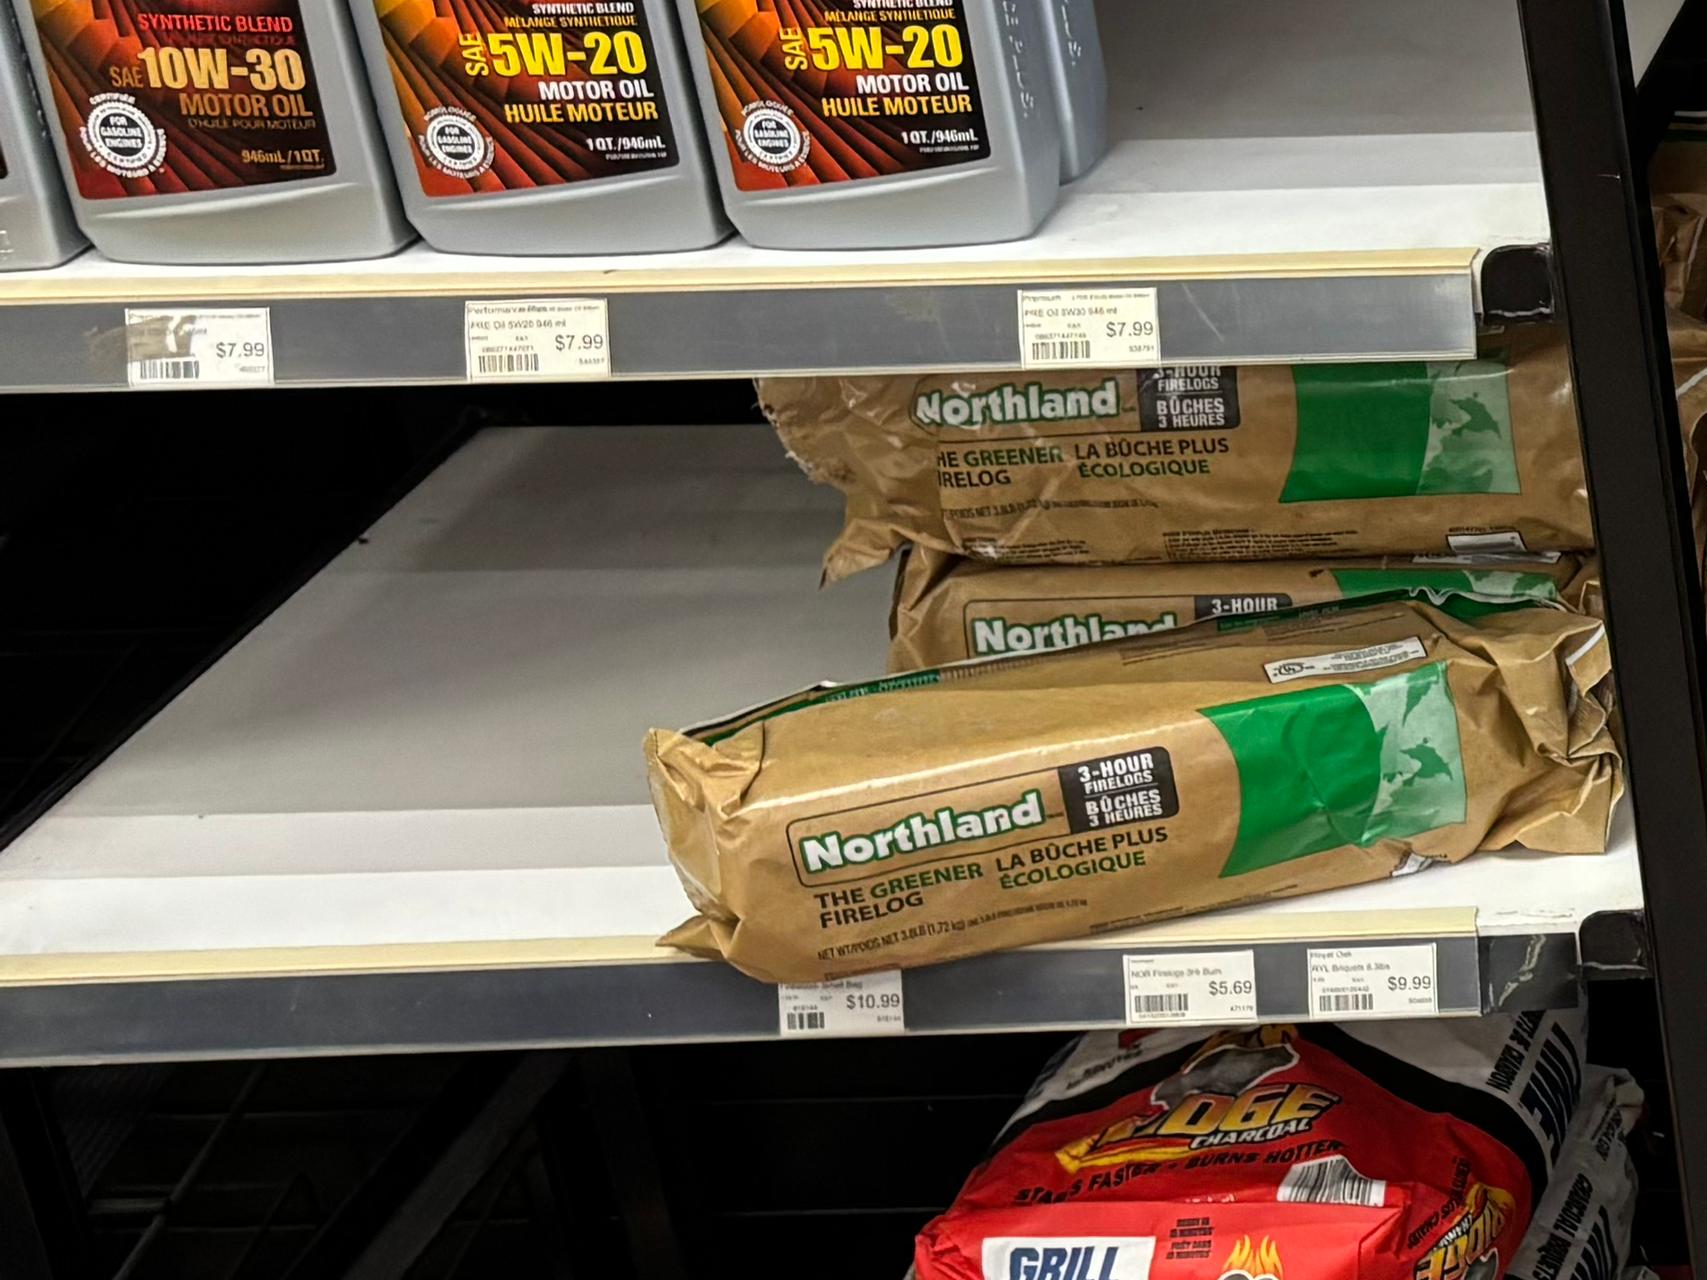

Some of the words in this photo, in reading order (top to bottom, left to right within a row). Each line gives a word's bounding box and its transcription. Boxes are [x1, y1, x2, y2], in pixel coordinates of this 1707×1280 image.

[137, 13, 232, 33] SYNTHETIC
[236, 16, 293, 33] BLEND
[487, 30, 647, 77] 5W-20
[807, 24, 963, 70] 5W-20
[110, 66, 144, 88] SAE
[137, 47, 306, 91] 10W-30
[856, 74, 931, 94] MOTOR
[935, 72, 969, 91] OIL
[180, 93, 269, 117] MOTOR
[272, 94, 314, 117] OIL
[822, 97, 881, 117] HUILE
[884, 95, 972, 115] MOTEUR
[1106, 321, 1154, 338] $7.99
[216, 342, 265, 358] $7.99
[555, 334, 603, 351] $7.99
[914, 378, 1120, 428] Northland
[964, 447, 1064, 467] GREENER
[1079, 460, 1211, 480] ÉCOLOGIQUE
[1211, 597, 1278, 615] 3-HOUR
[1078, 752, 1153, 782] 3-HOUR
[1085, 770, 1152, 794] FIRELOGS
[1086, 789, 1161, 816] BÛCHES
[1089, 814, 1100, 827] 3
[1104, 804, 1162, 824] HEURES
[800, 789, 1046, 873] Northland
[996, 853, 1024, 872] LA
[1030, 836, 1105, 864] BÛCHE
[1111, 826, 1168, 850] PLUS
[1000, 850, 1146, 889] ÉCOLOGIQUE
[815, 887, 865, 909] THE
[870, 862, 984, 898] GREENER
[819, 892, 924, 928] FIRELOG
[1208, 980, 1252, 996] $5.69
[1387, 976, 1431, 991] $9.99
[846, 994, 900, 1009] $10.99
[1190, 1118, 1313, 1148] CHARCOAL
